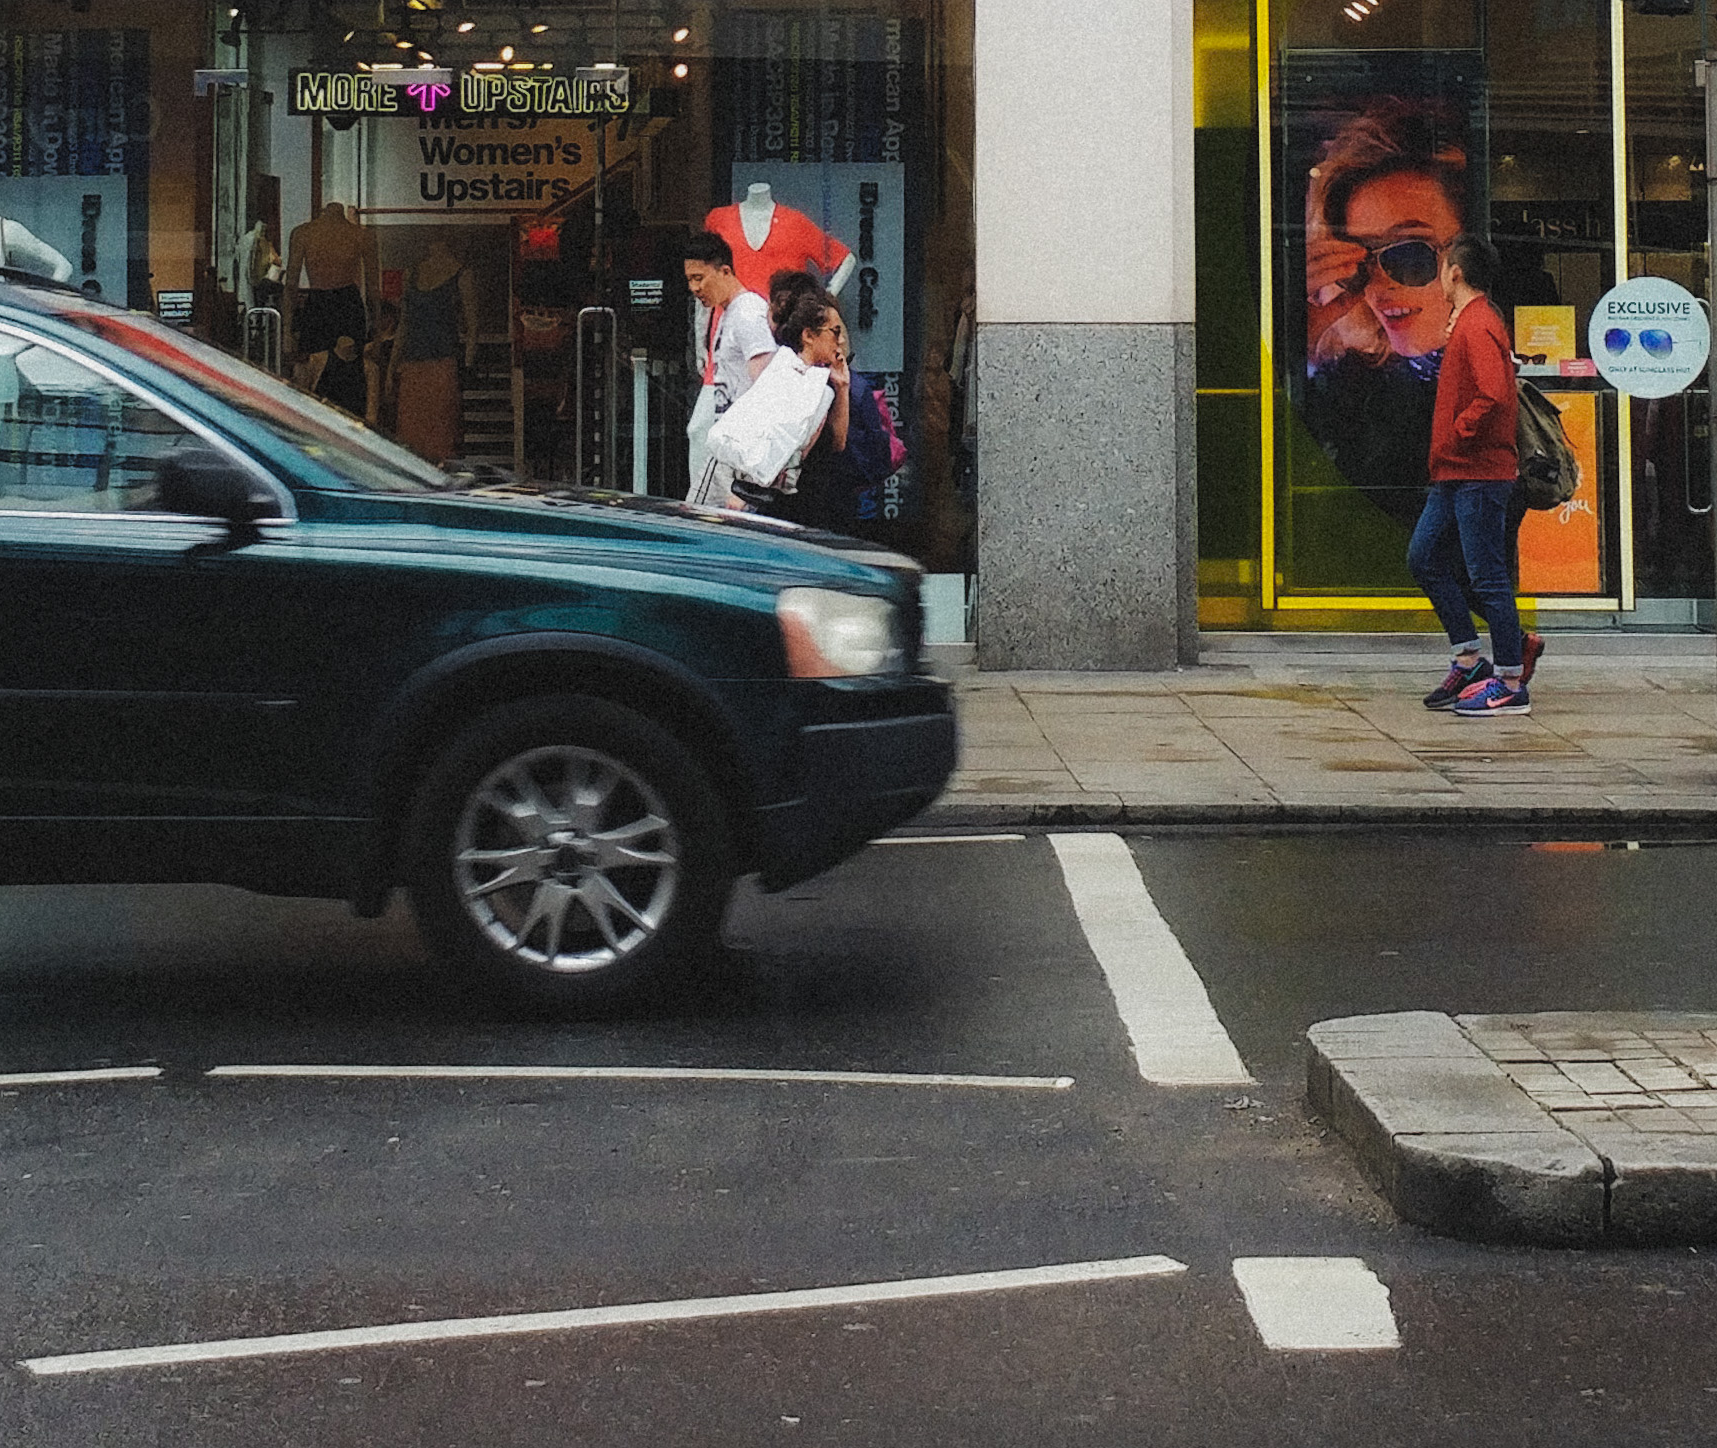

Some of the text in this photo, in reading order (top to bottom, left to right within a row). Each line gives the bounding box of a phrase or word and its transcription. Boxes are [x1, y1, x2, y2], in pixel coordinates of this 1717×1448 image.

[296, 72, 630, 114] MORE UPSTAIRS
[419, 135, 582, 167] Women's
[420, 172, 571, 207] Upstairs
[1607, 301, 1691, 315] EXCLUSIVE
